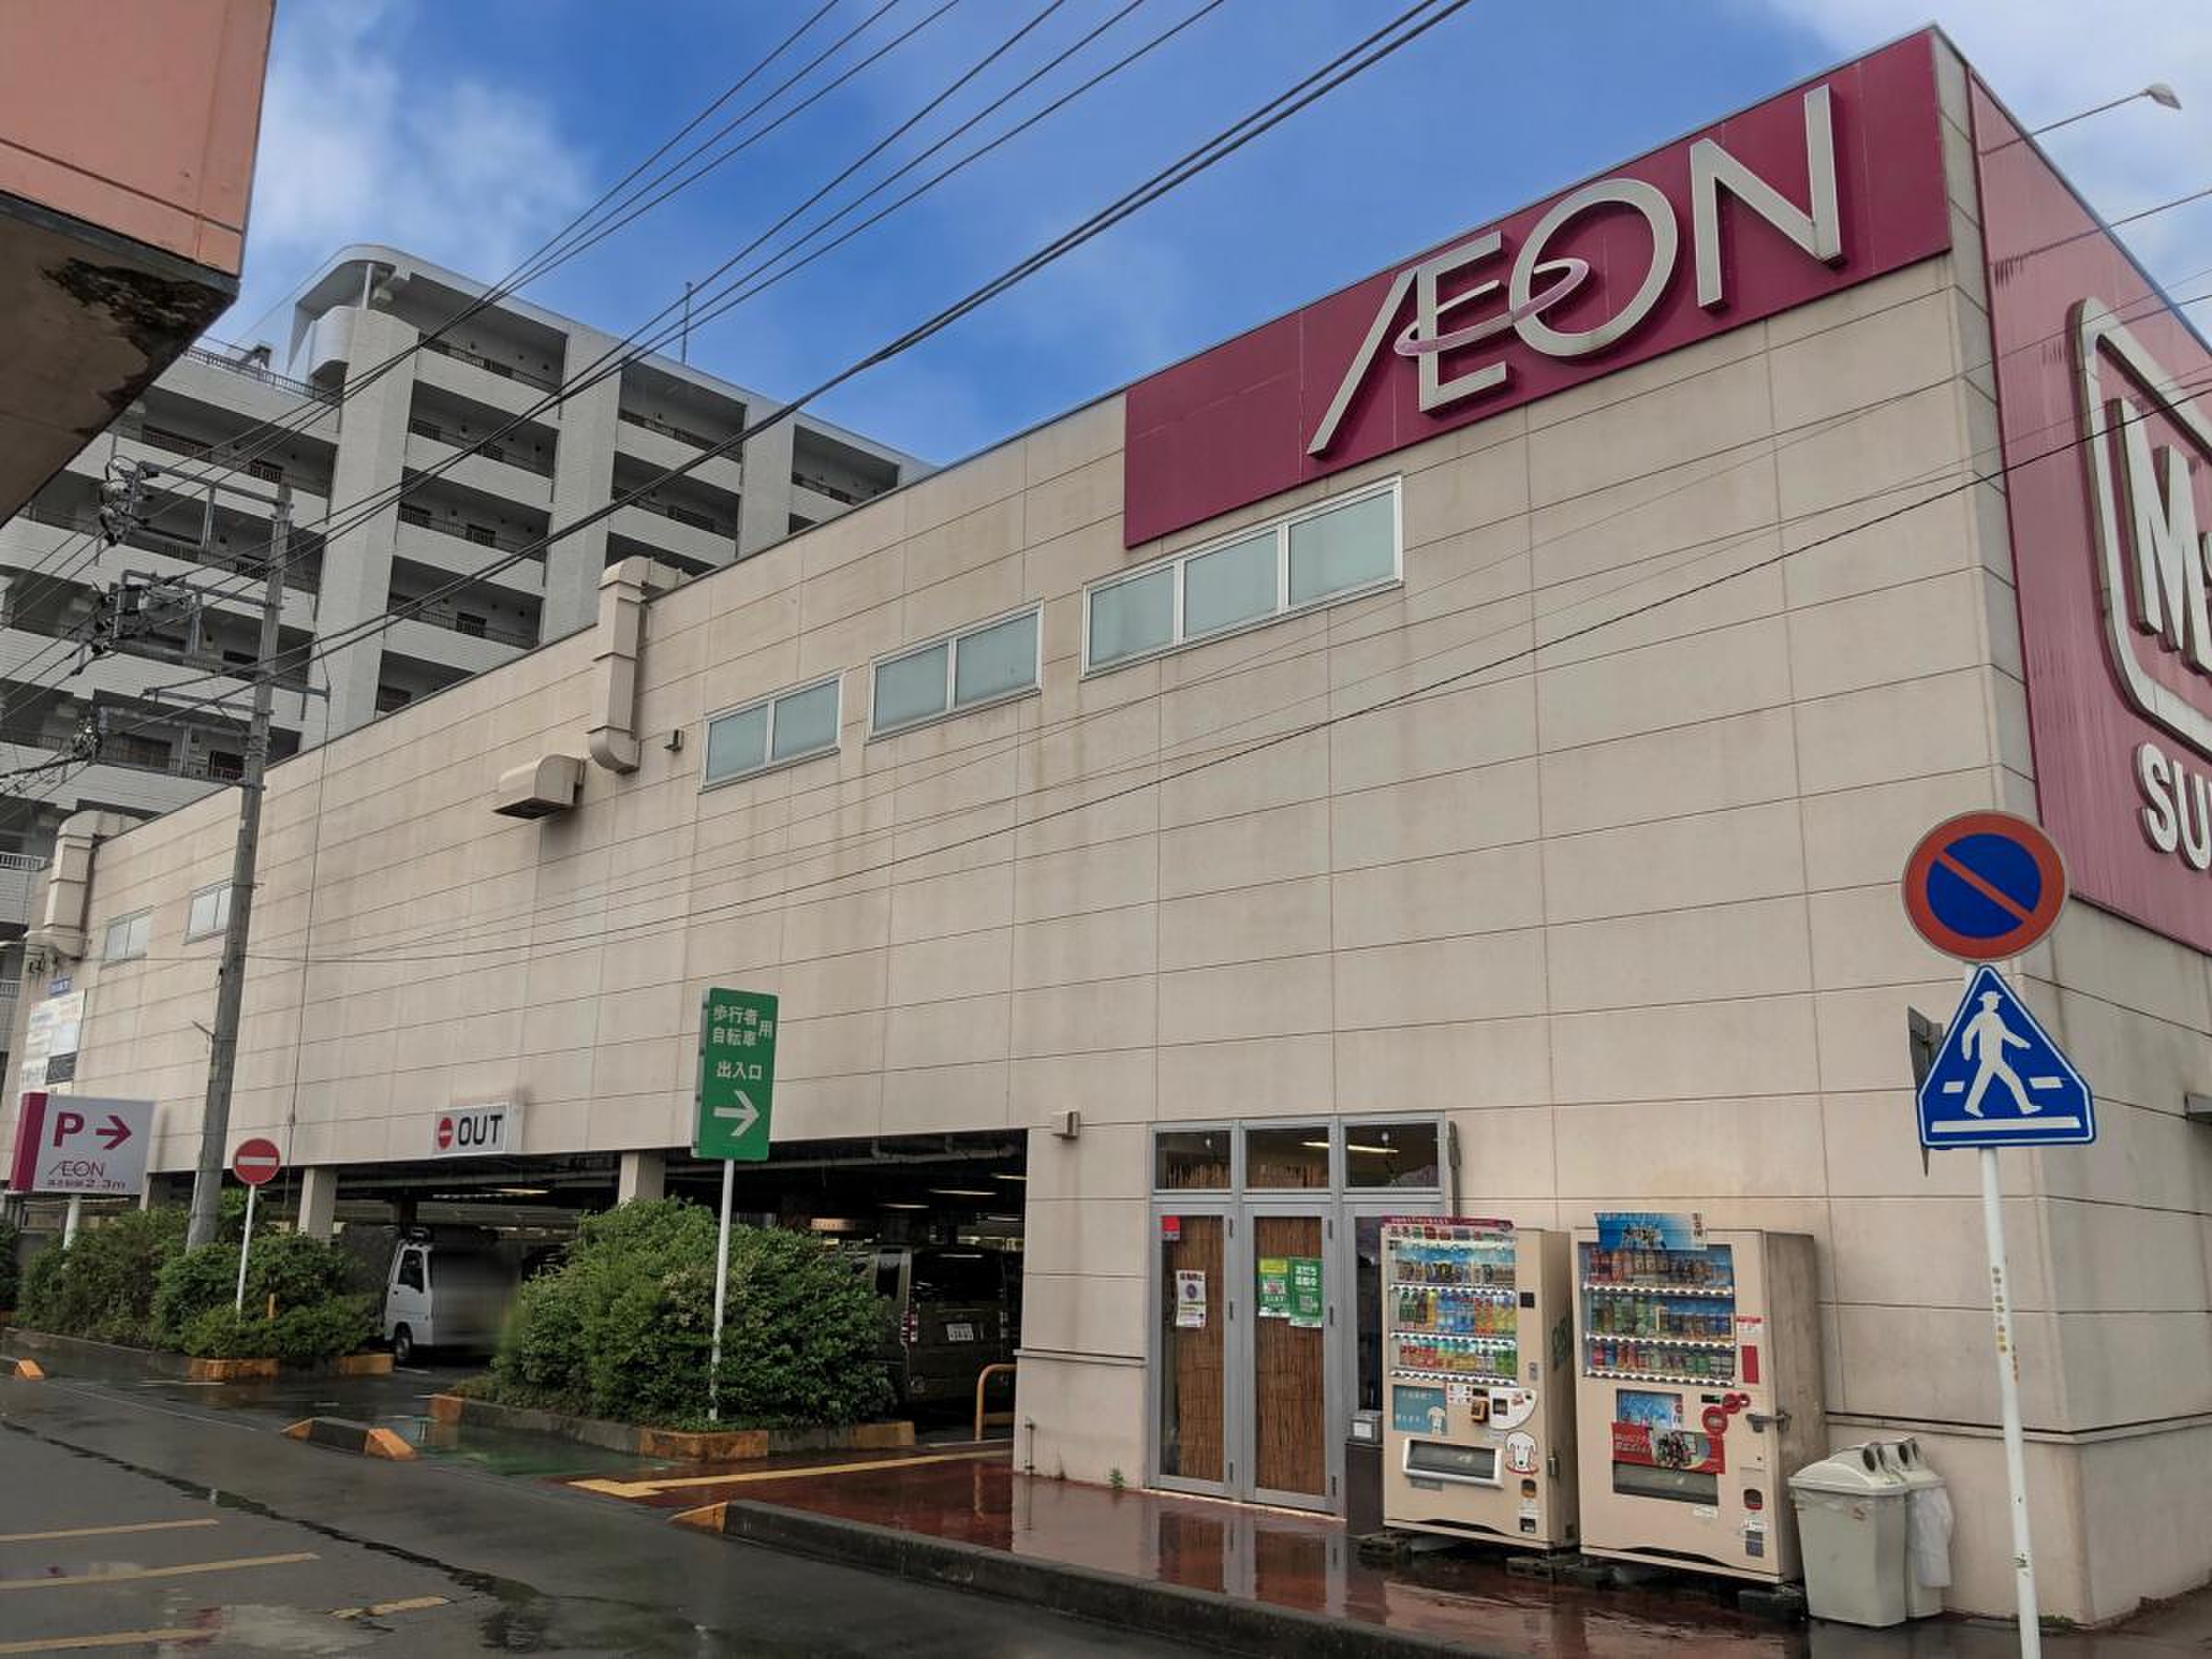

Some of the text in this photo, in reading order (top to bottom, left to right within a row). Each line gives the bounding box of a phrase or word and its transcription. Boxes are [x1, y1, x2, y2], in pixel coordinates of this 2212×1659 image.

[2113, 396, 2212, 675] M
[2133, 742, 2212, 870] SU
[714, 1004, 758, 1025] 歩行者
[712, 1027, 756, 1046] 自転車
[759, 1020, 773, 1039] 用
[717, 1060, 762, 1079] 出入口
[53, 1111, 85, 1147] P
[457, 1112, 503, 1147] OUT
